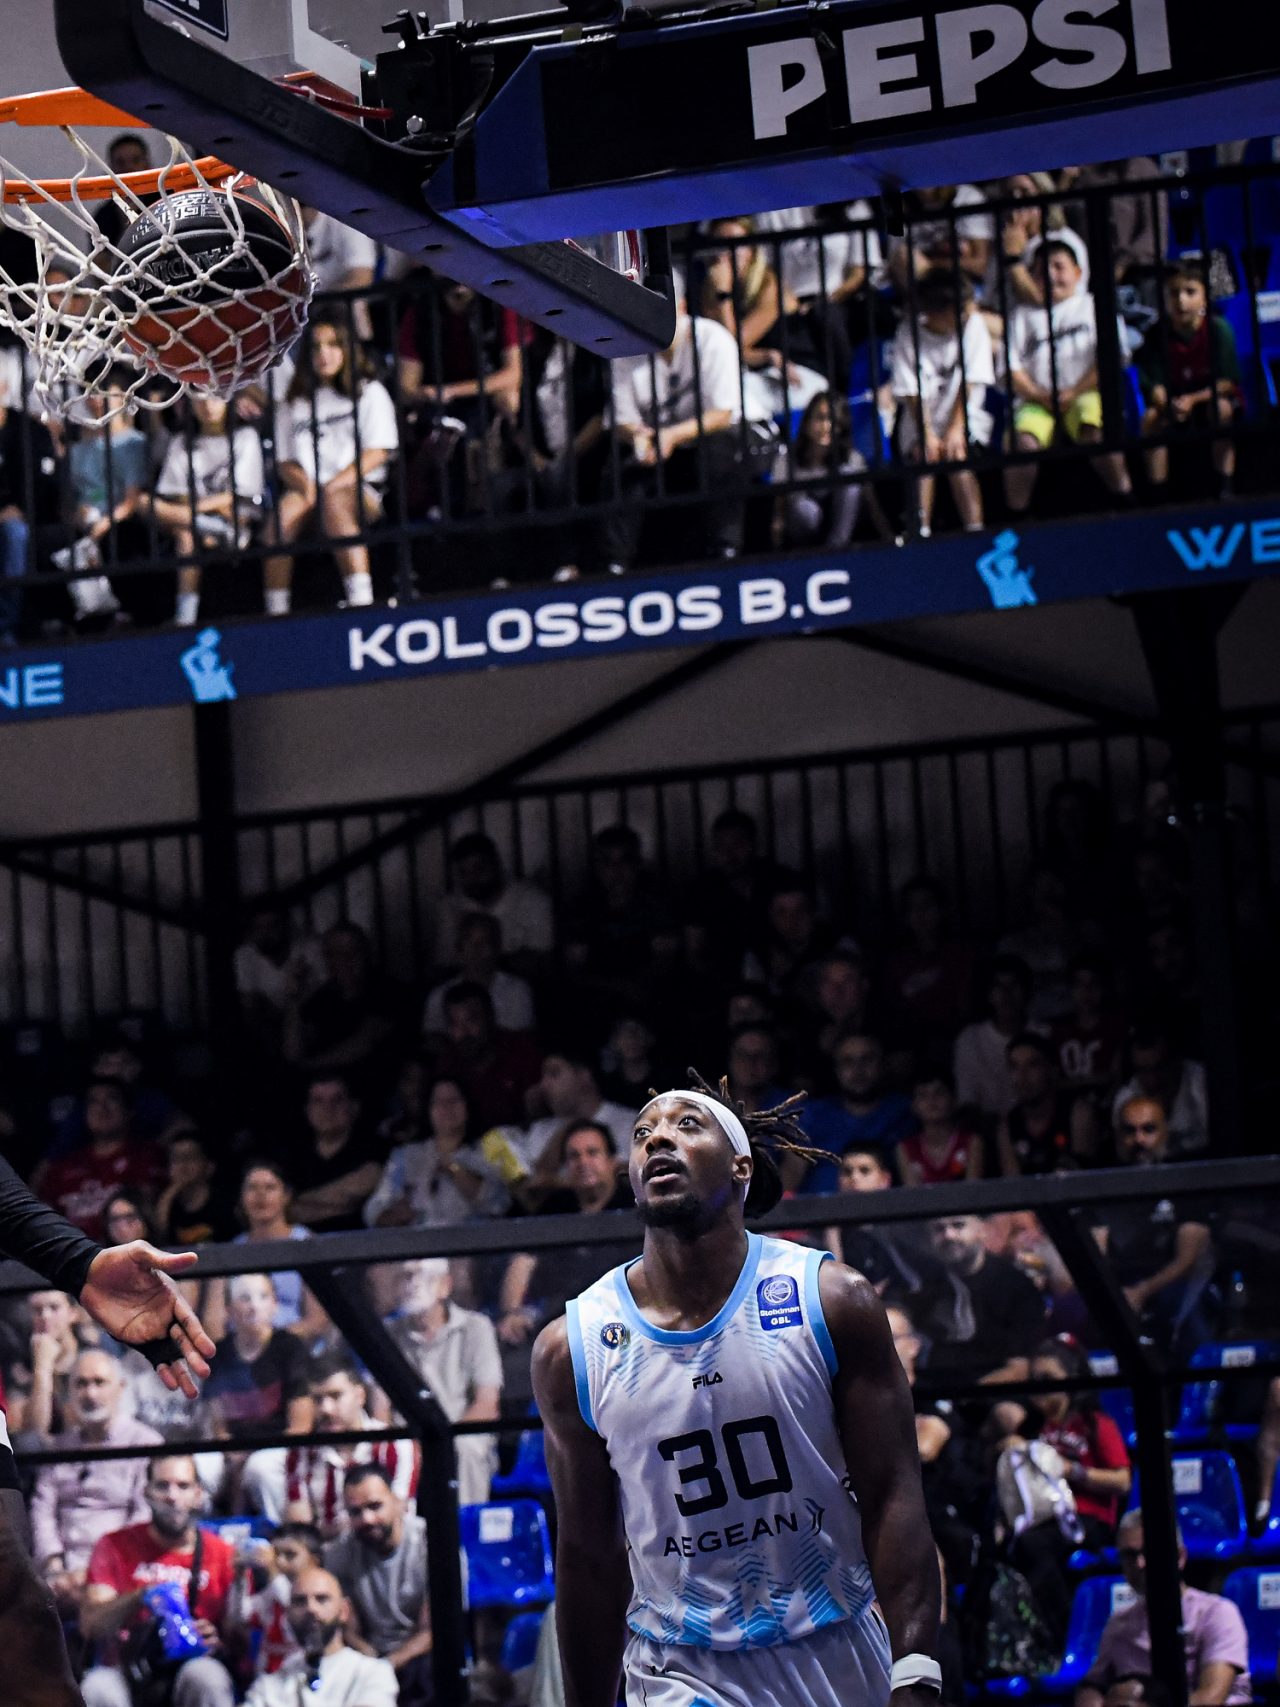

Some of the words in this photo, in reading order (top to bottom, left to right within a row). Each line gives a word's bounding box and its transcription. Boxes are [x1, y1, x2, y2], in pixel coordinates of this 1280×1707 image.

[747, 0, 1173, 140] PEPSI
[1166, 518, 1280, 570] WE
[349, 586, 722, 670] KOLOSSOS
[739, 569, 851, 625] B.C
[691, 1371, 723, 1390] FILA
[657, 1415, 793, 1517] 30
[663, 1512, 799, 1558] AEGEAN
